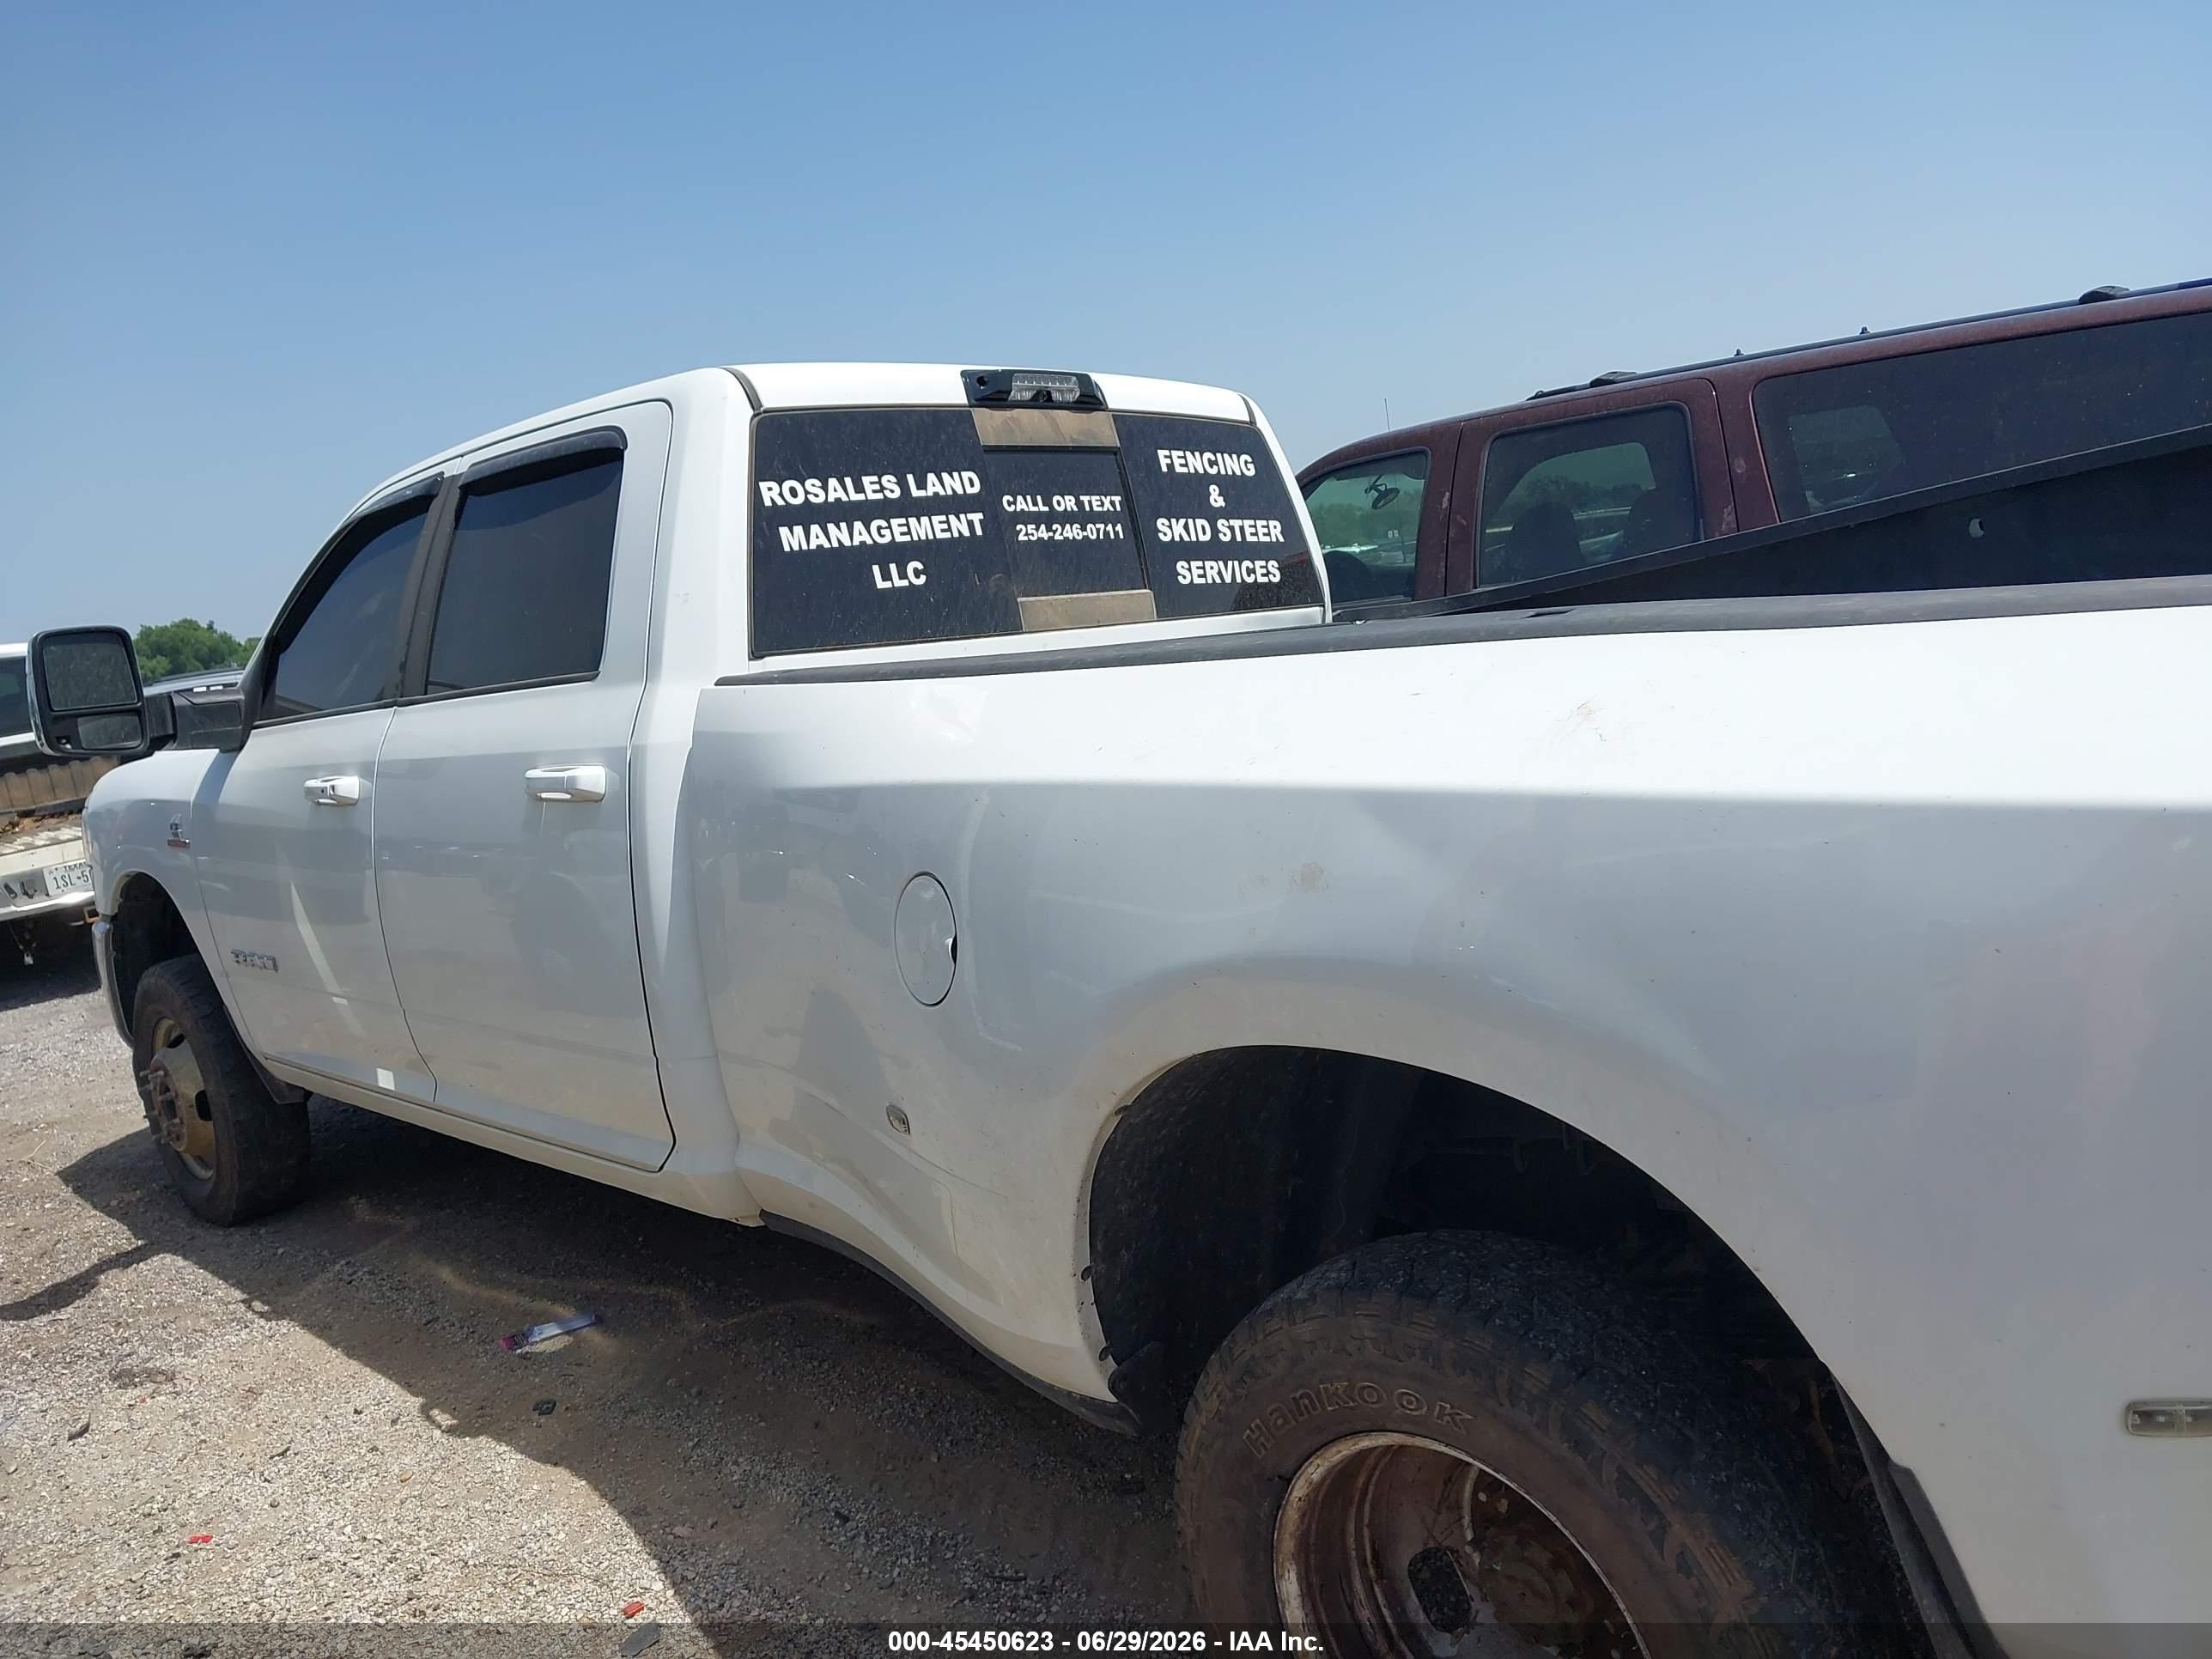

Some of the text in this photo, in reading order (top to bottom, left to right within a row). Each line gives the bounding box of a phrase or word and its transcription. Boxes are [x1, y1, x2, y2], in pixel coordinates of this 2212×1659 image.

[1157, 449, 1256, 477] FENCING
[758, 471, 981, 507] ROSALES LAND
[1208, 484, 1226, 507] &
[1002, 495, 1122, 512] CALL OR TEXT
[778, 512, 985, 551] MANAGEMENT
[1015, 523, 1124, 541] 254-246-0711
[1156, 517, 1285, 543] SKID STEER
[872, 560, 927, 589] LLC
[1176, 560, 1281, 584] SERVICES
